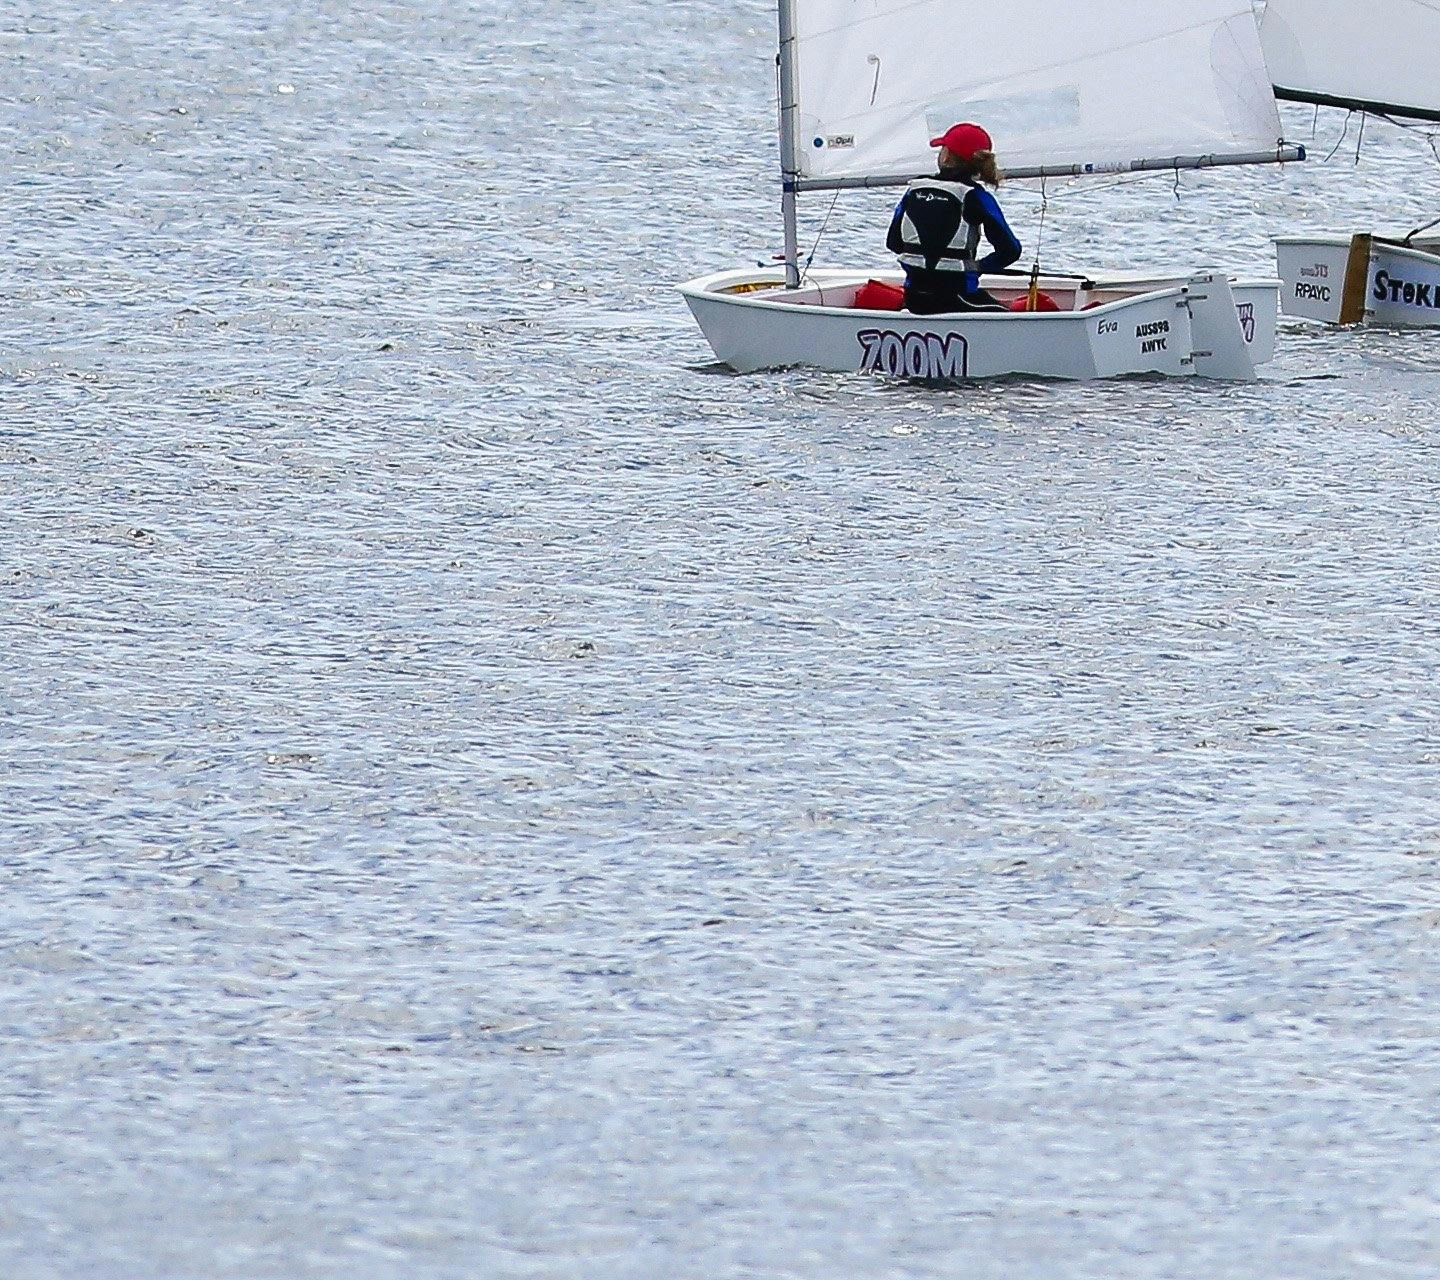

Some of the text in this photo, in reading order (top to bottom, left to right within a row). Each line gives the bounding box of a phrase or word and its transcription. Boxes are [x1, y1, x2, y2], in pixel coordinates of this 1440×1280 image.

[1295, 282, 1330, 302] RPAYC
[1097, 319, 1118, 335] Eva
[1136, 320, 1170, 338] AUS898
[856, 328, 969, 378] ZOOM
